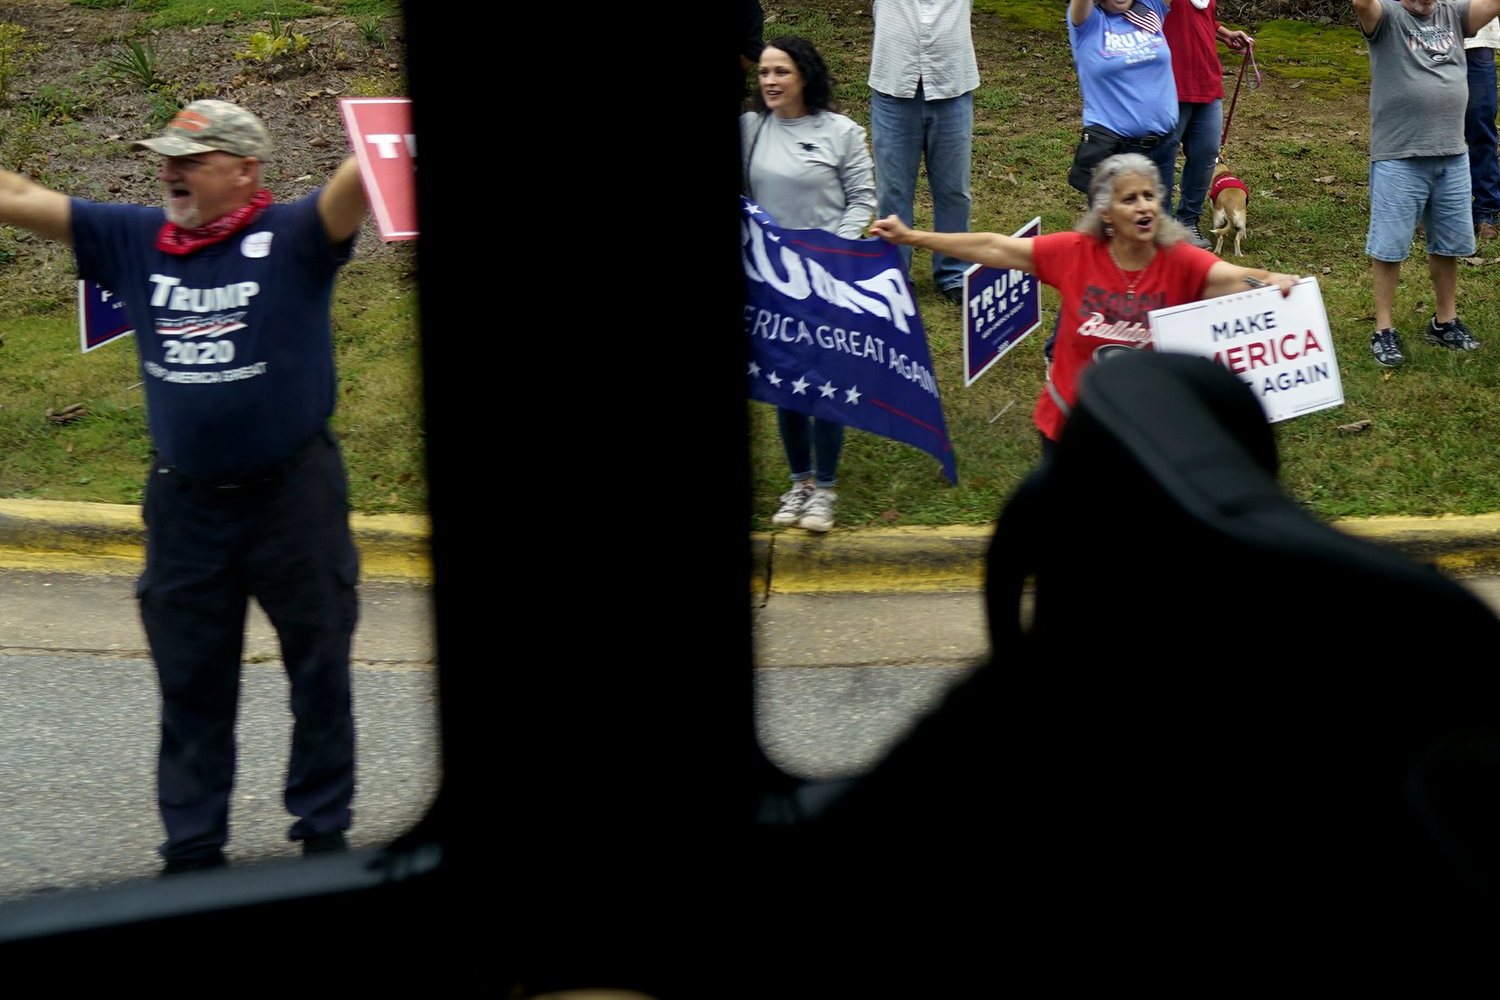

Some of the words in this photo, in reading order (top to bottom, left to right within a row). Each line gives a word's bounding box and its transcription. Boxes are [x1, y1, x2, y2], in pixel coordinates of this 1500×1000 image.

[149, 273, 260, 312] TRUMP
[969, 268, 1031, 318] TRUM
[975, 280, 1030, 332] PENCE
[1211, 311, 1277, 342] MAKE
[162, 340, 235, 365] 2020
[815, 325, 885, 364] GREAT
[889, 347, 939, 398] AGAIN
[1204, 329, 1325, 375] MERICA
[1262, 362, 1330, 397] AGAIN
